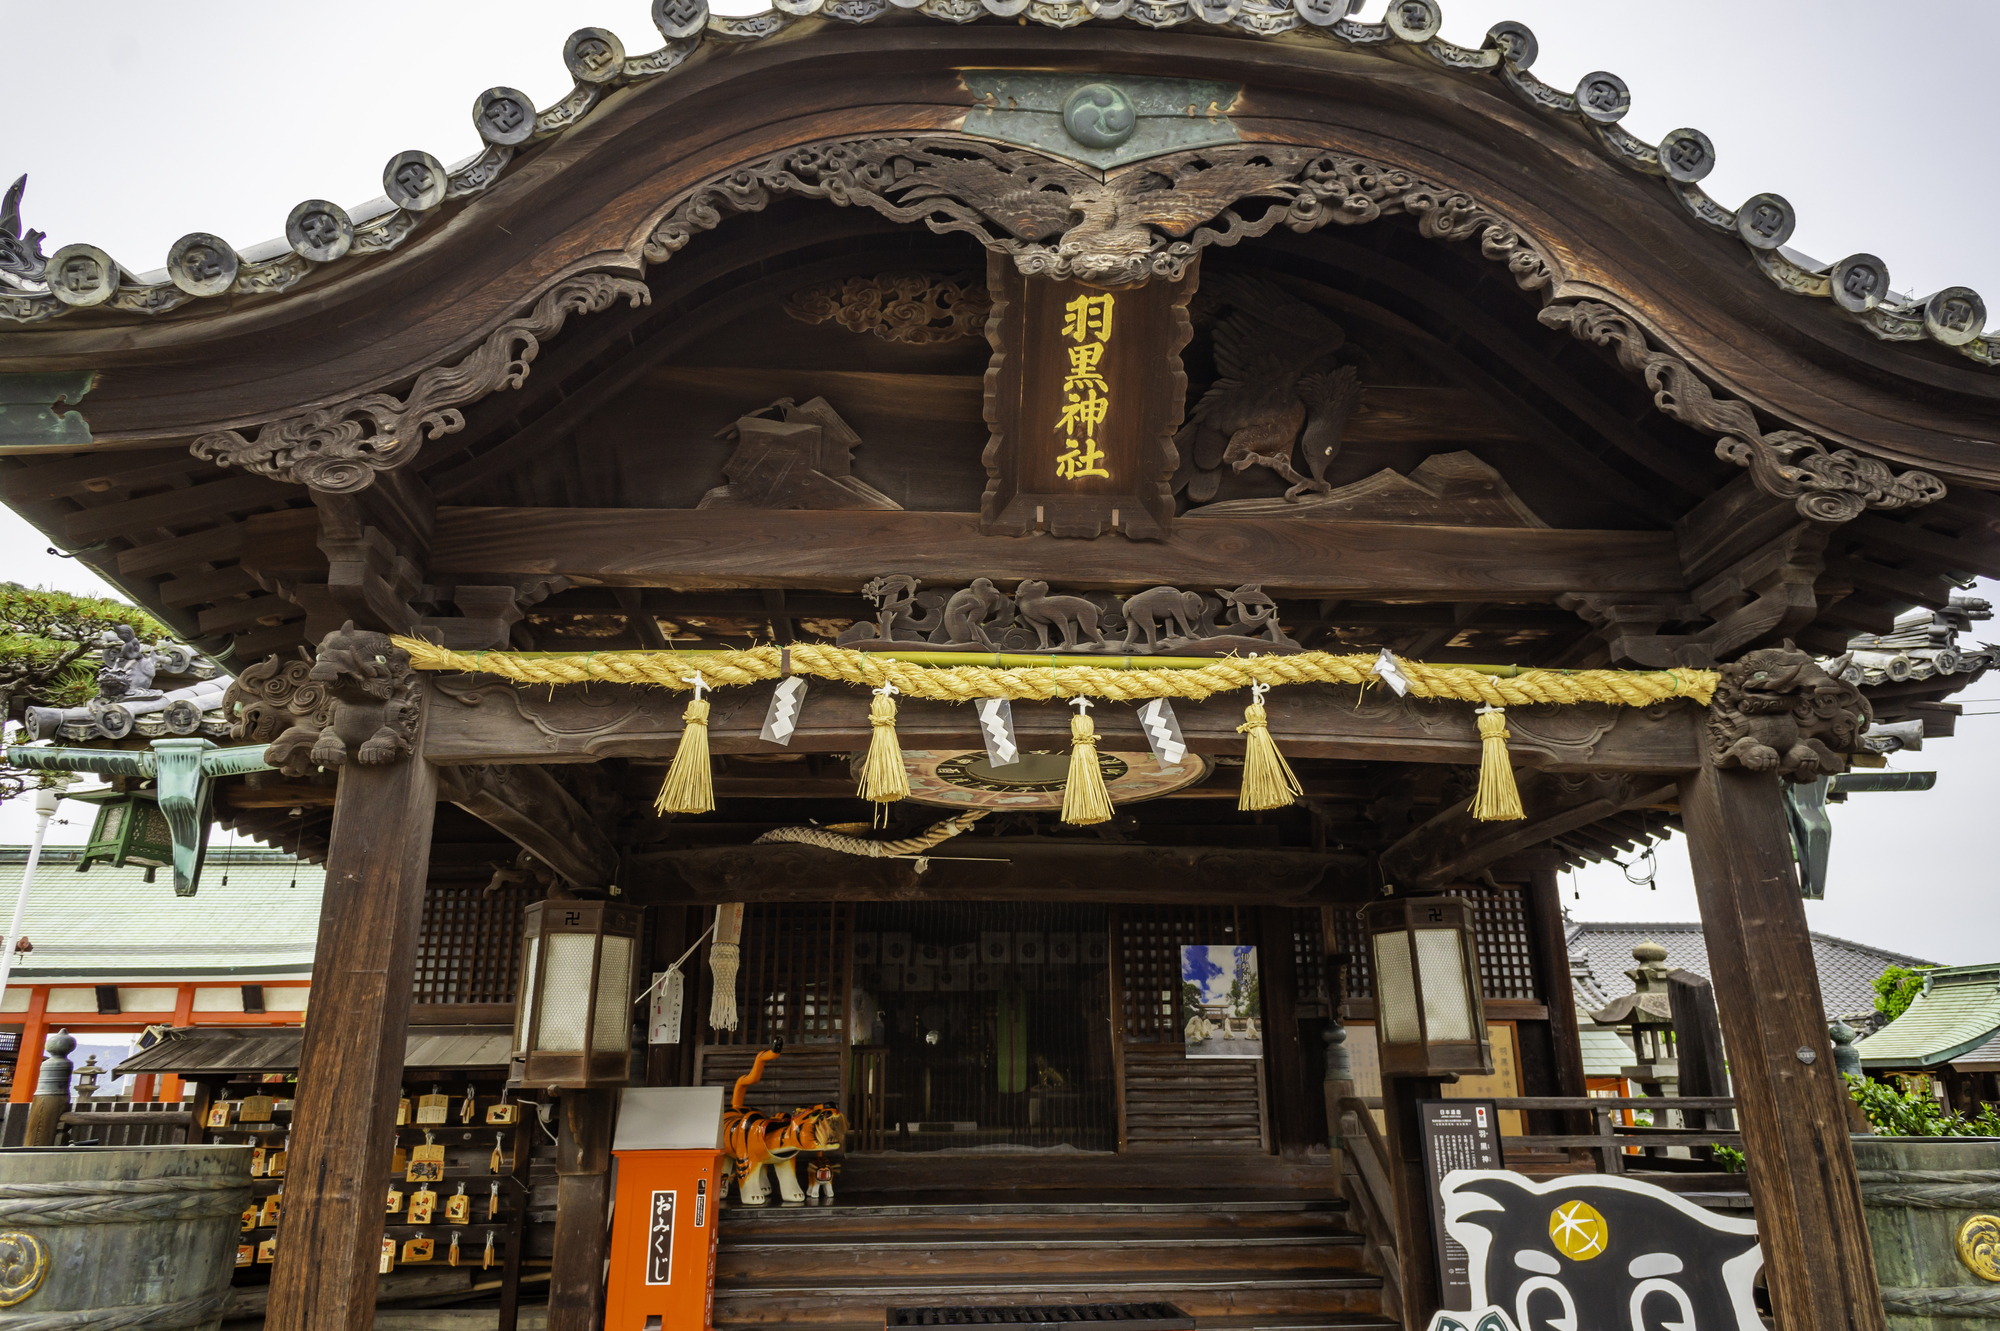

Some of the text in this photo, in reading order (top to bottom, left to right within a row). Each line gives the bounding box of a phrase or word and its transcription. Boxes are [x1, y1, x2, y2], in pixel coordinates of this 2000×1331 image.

[1054, 293, 1115, 480] 羽黒神社
[1478, 1129, 1490, 1170] 羽黒神
[653, 1195, 673, 1281] おみくじ
